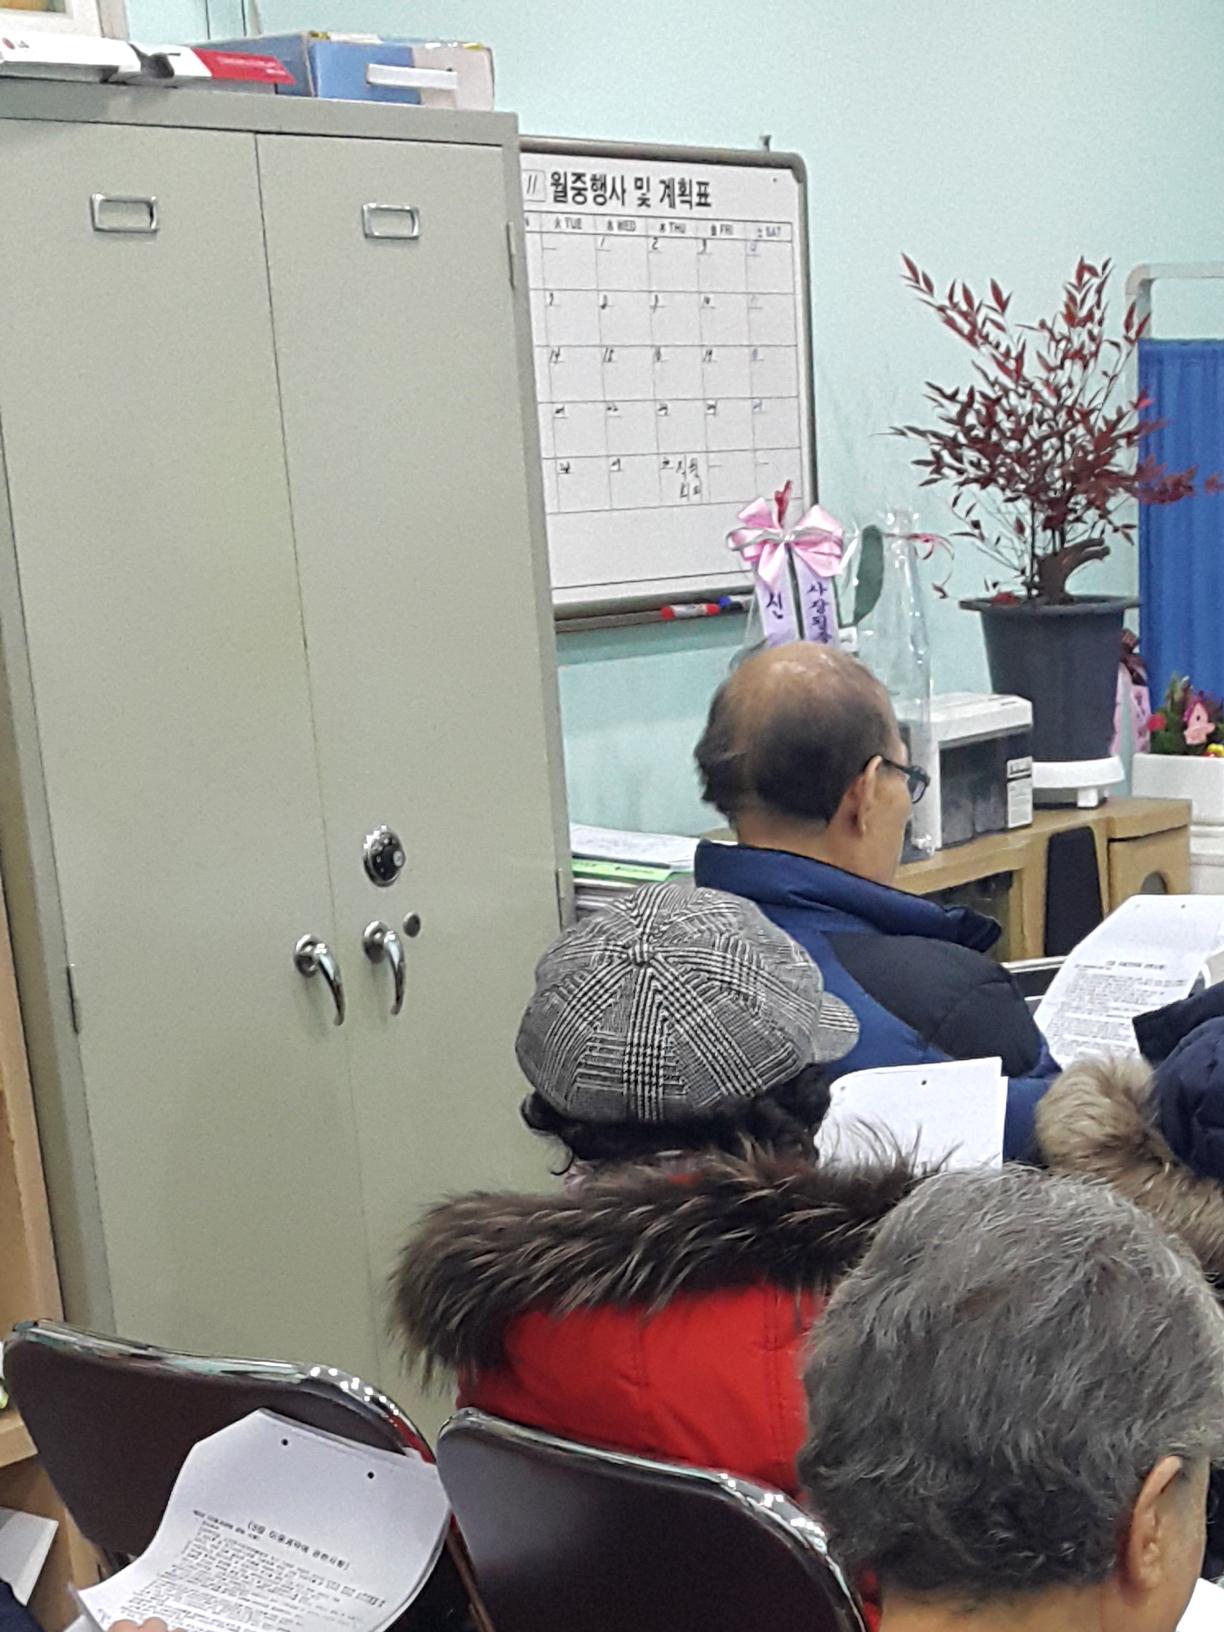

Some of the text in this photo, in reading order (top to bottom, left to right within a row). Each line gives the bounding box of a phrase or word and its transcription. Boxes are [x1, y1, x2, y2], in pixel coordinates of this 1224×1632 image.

[551, 170, 712, 210] 월중행사 및 계획표
